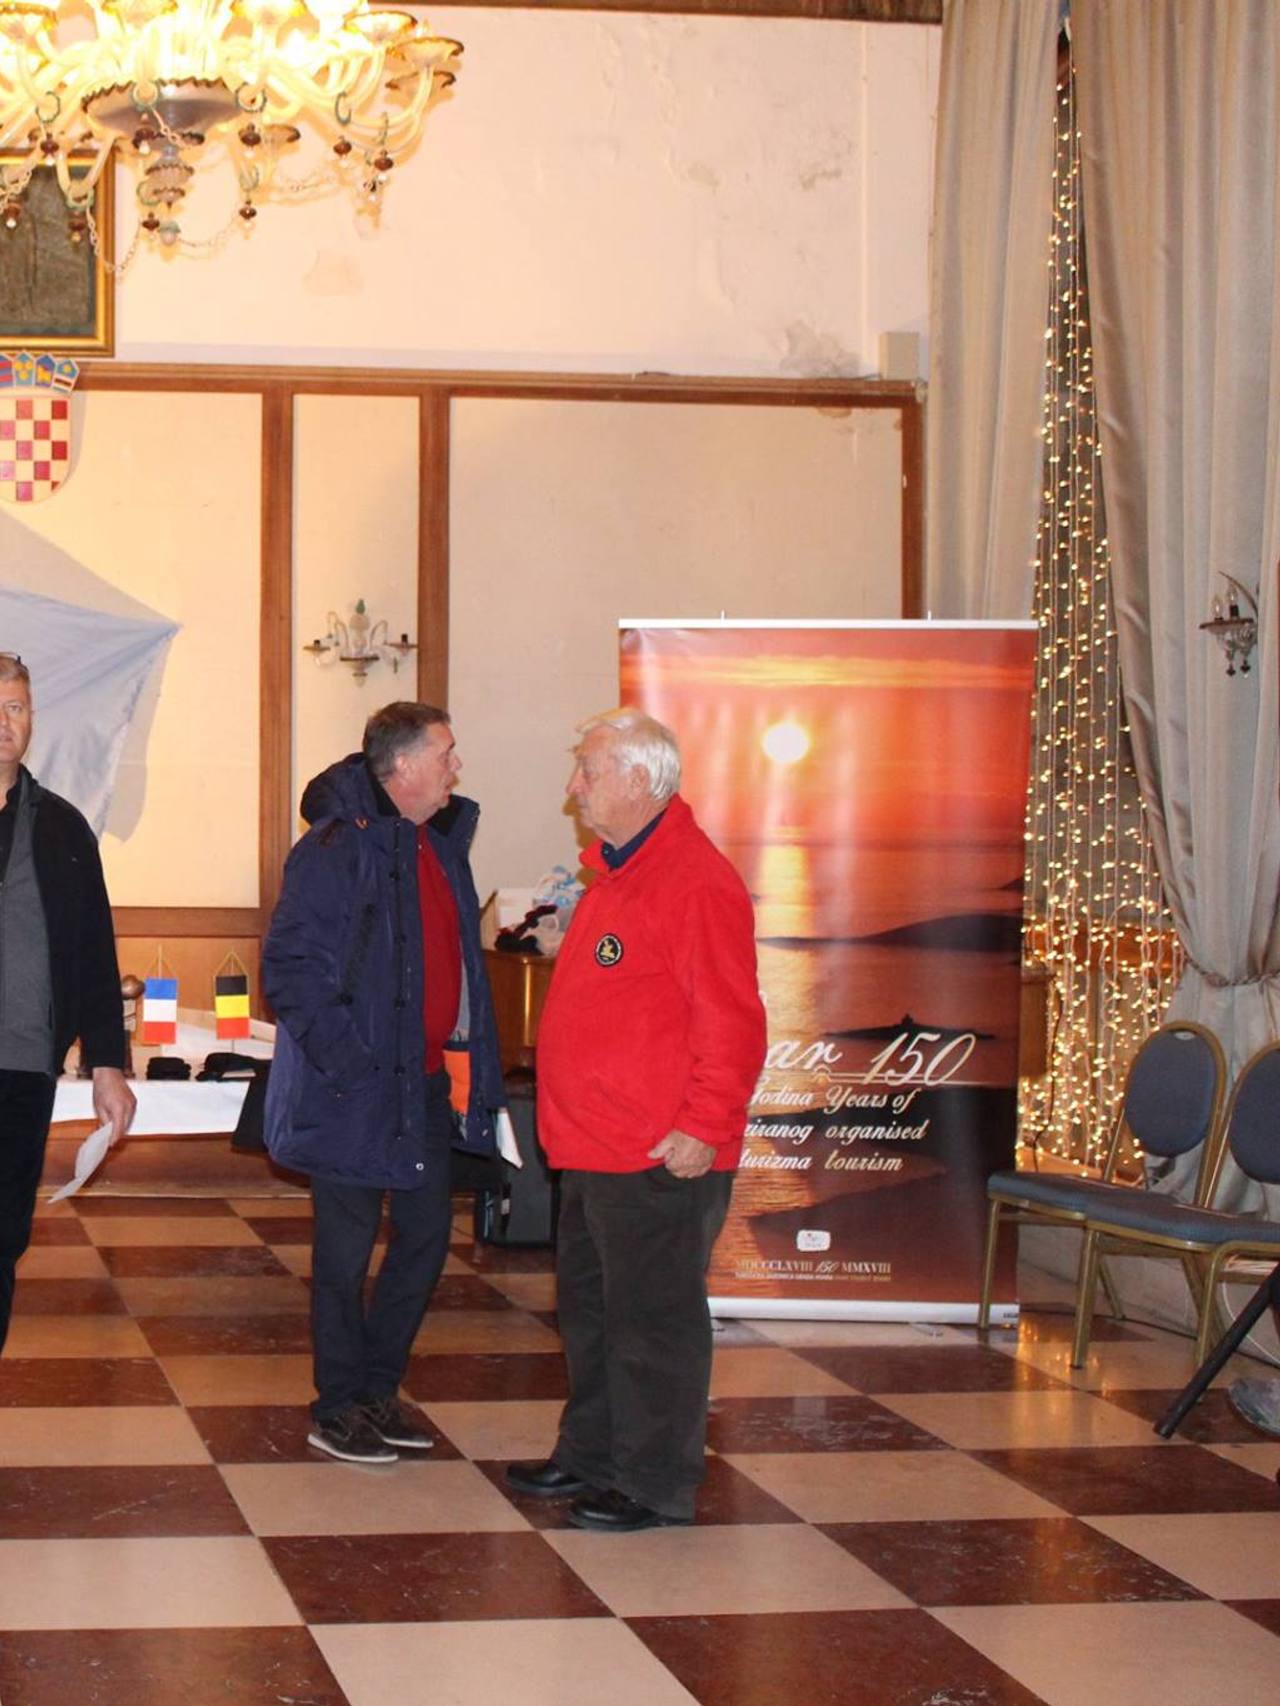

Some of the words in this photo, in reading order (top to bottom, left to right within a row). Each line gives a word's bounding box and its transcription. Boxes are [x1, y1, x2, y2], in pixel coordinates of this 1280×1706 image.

[764, 1040, 843, 1070] ar
[862, 1032, 976, 1086] 150
[823, 1085, 887, 1115] Years
[892, 1088, 922, 1114] of
[824, 1119, 931, 1145] organised
[738, 1148, 812, 1170] turizma
[824, 1150, 903, 1171] tourism
[842, 1261, 891, 1273] MMXVIII
